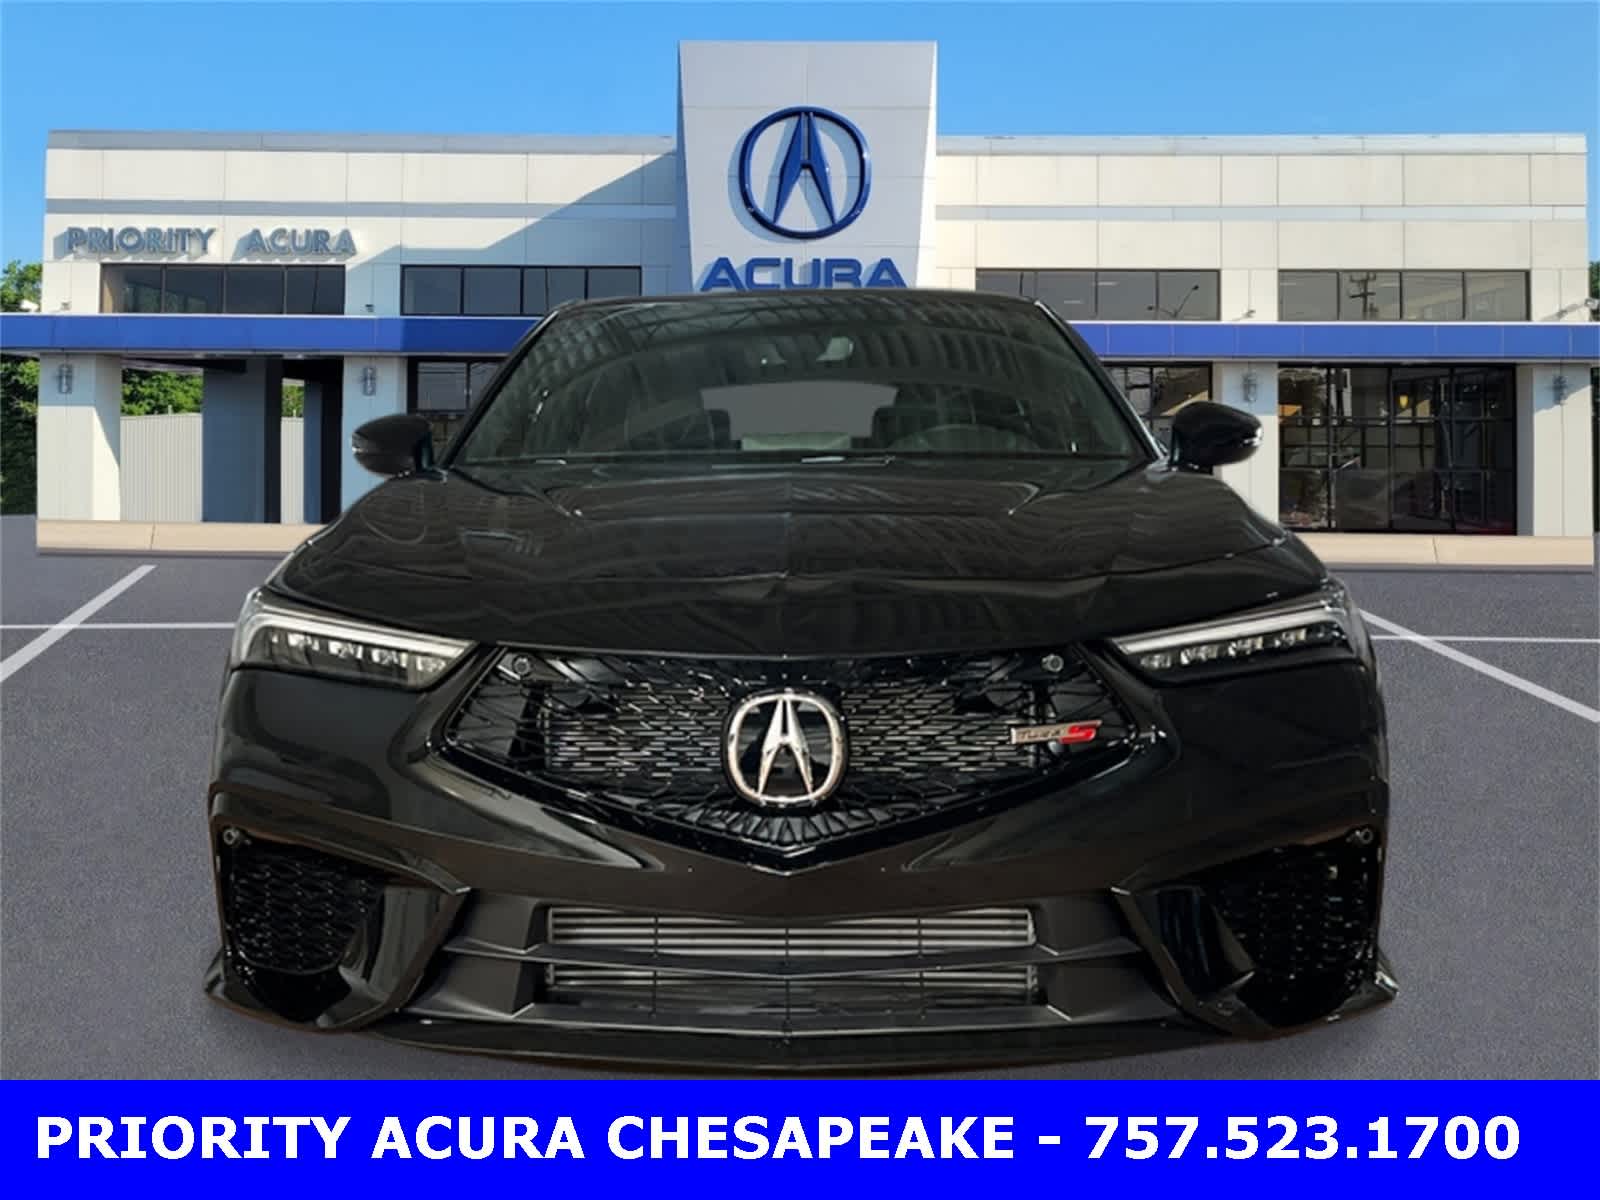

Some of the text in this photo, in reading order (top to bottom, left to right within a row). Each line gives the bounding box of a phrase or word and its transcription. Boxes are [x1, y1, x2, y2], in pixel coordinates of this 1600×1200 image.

[66, 227, 357, 255] PRIORITY ACURA
[700, 257, 908, 291] ACURA
